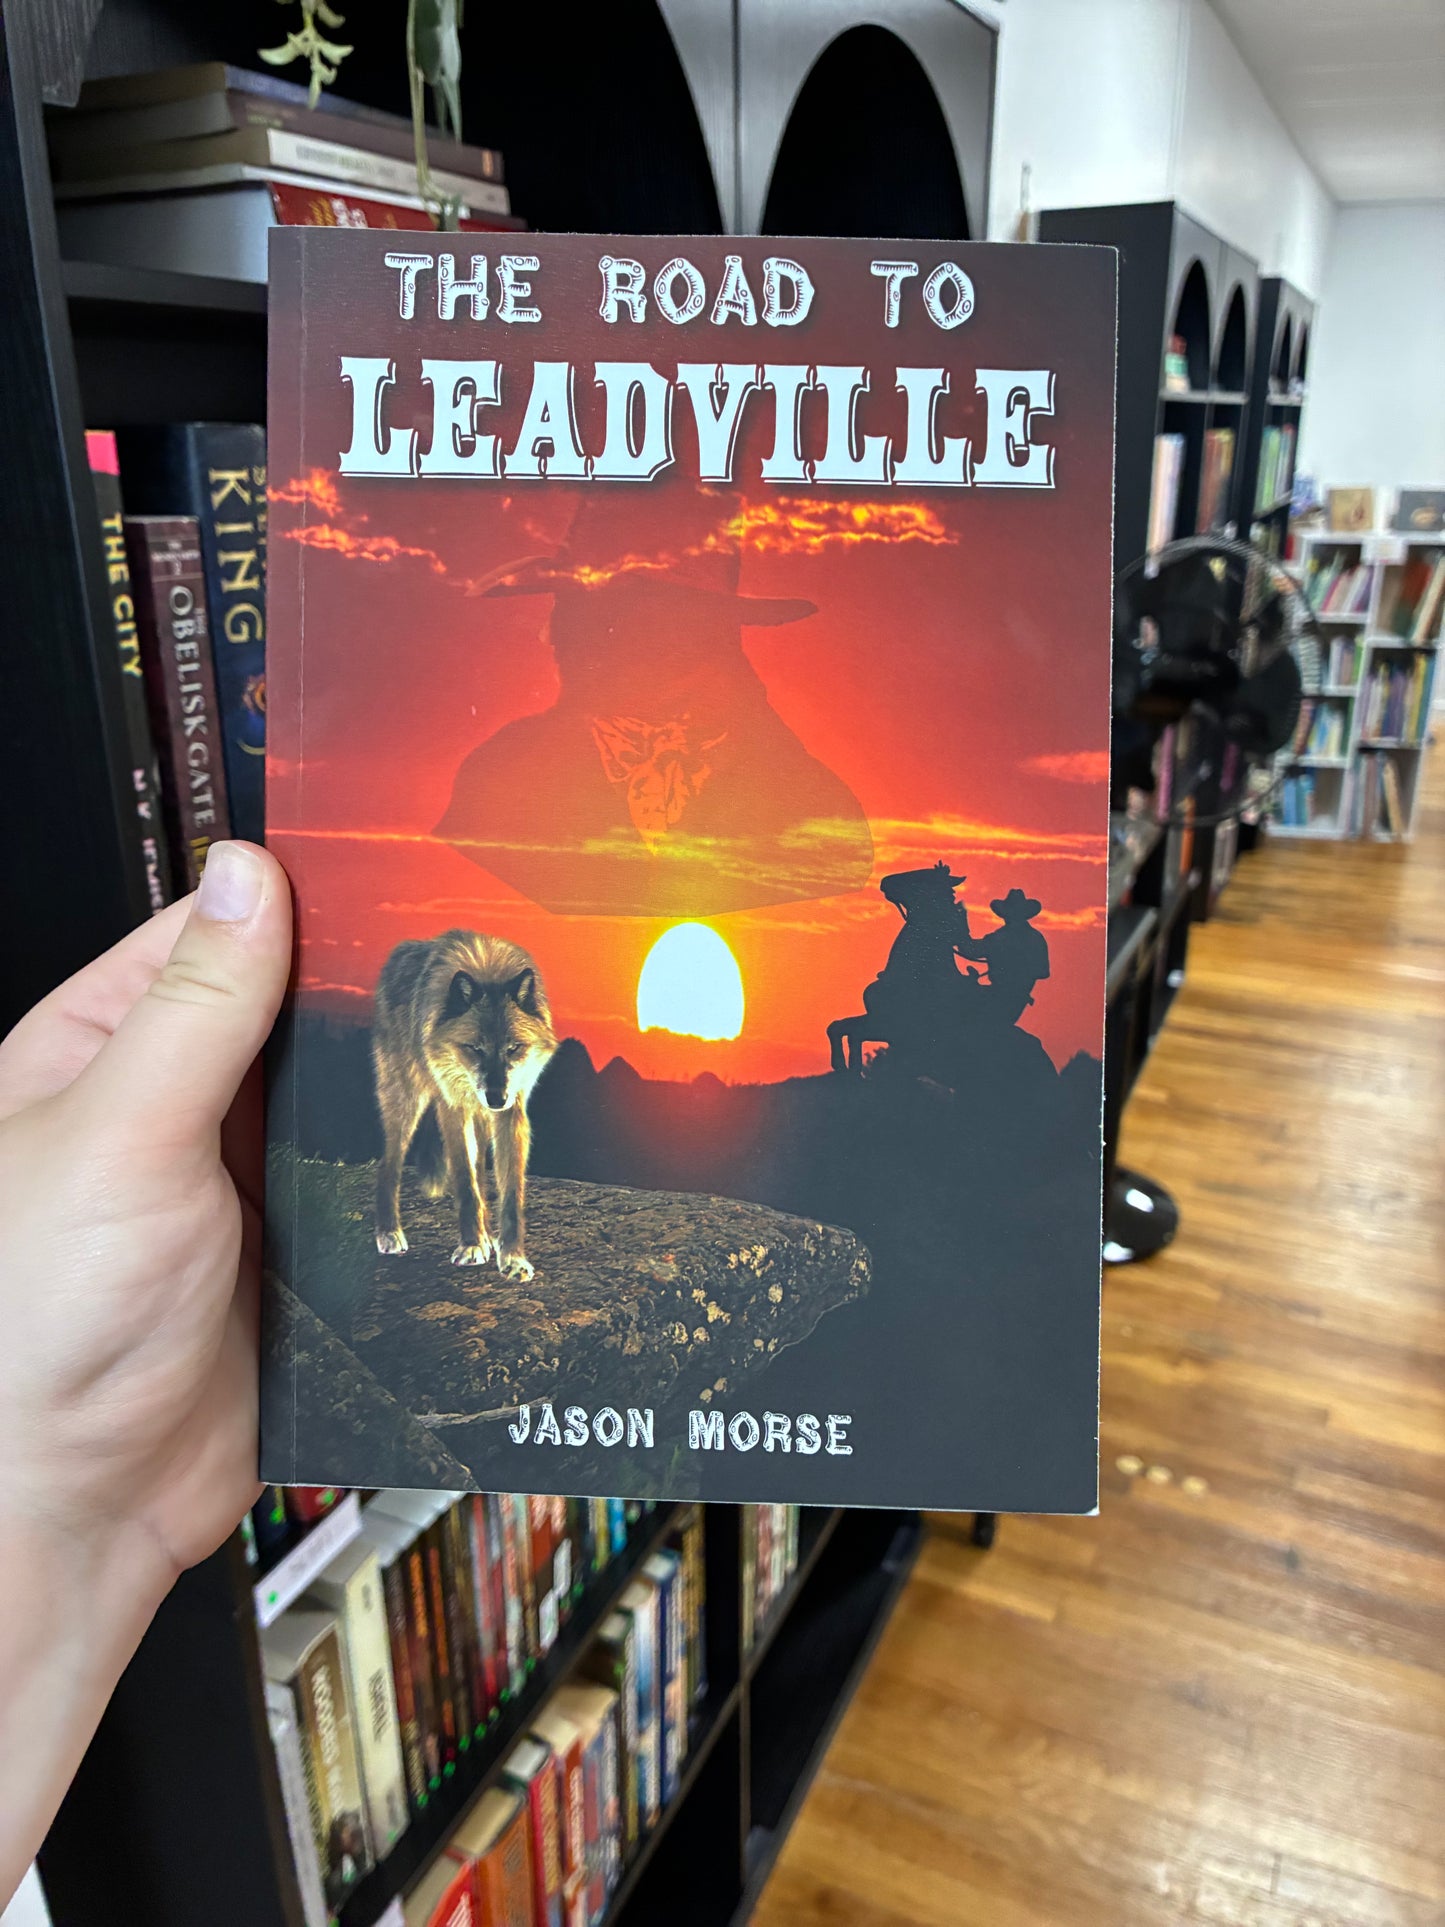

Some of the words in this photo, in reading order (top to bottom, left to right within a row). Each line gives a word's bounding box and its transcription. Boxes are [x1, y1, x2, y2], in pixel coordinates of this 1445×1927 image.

[384, 251, 542, 324] THE
[598, 254, 816, 327] ROAD
[869, 260, 976, 331] TO
[338, 355, 1056, 489] LEADVILLE
[102, 511, 130, 585] THE
[208, 467, 264, 644] KING
[113, 593, 143, 679] CITY
[169, 585, 208, 737] OBELISK
[188, 742, 216, 829] GATE
[507, 1402, 655, 1449] JASON
[688, 1409, 854, 1456] MORSE
